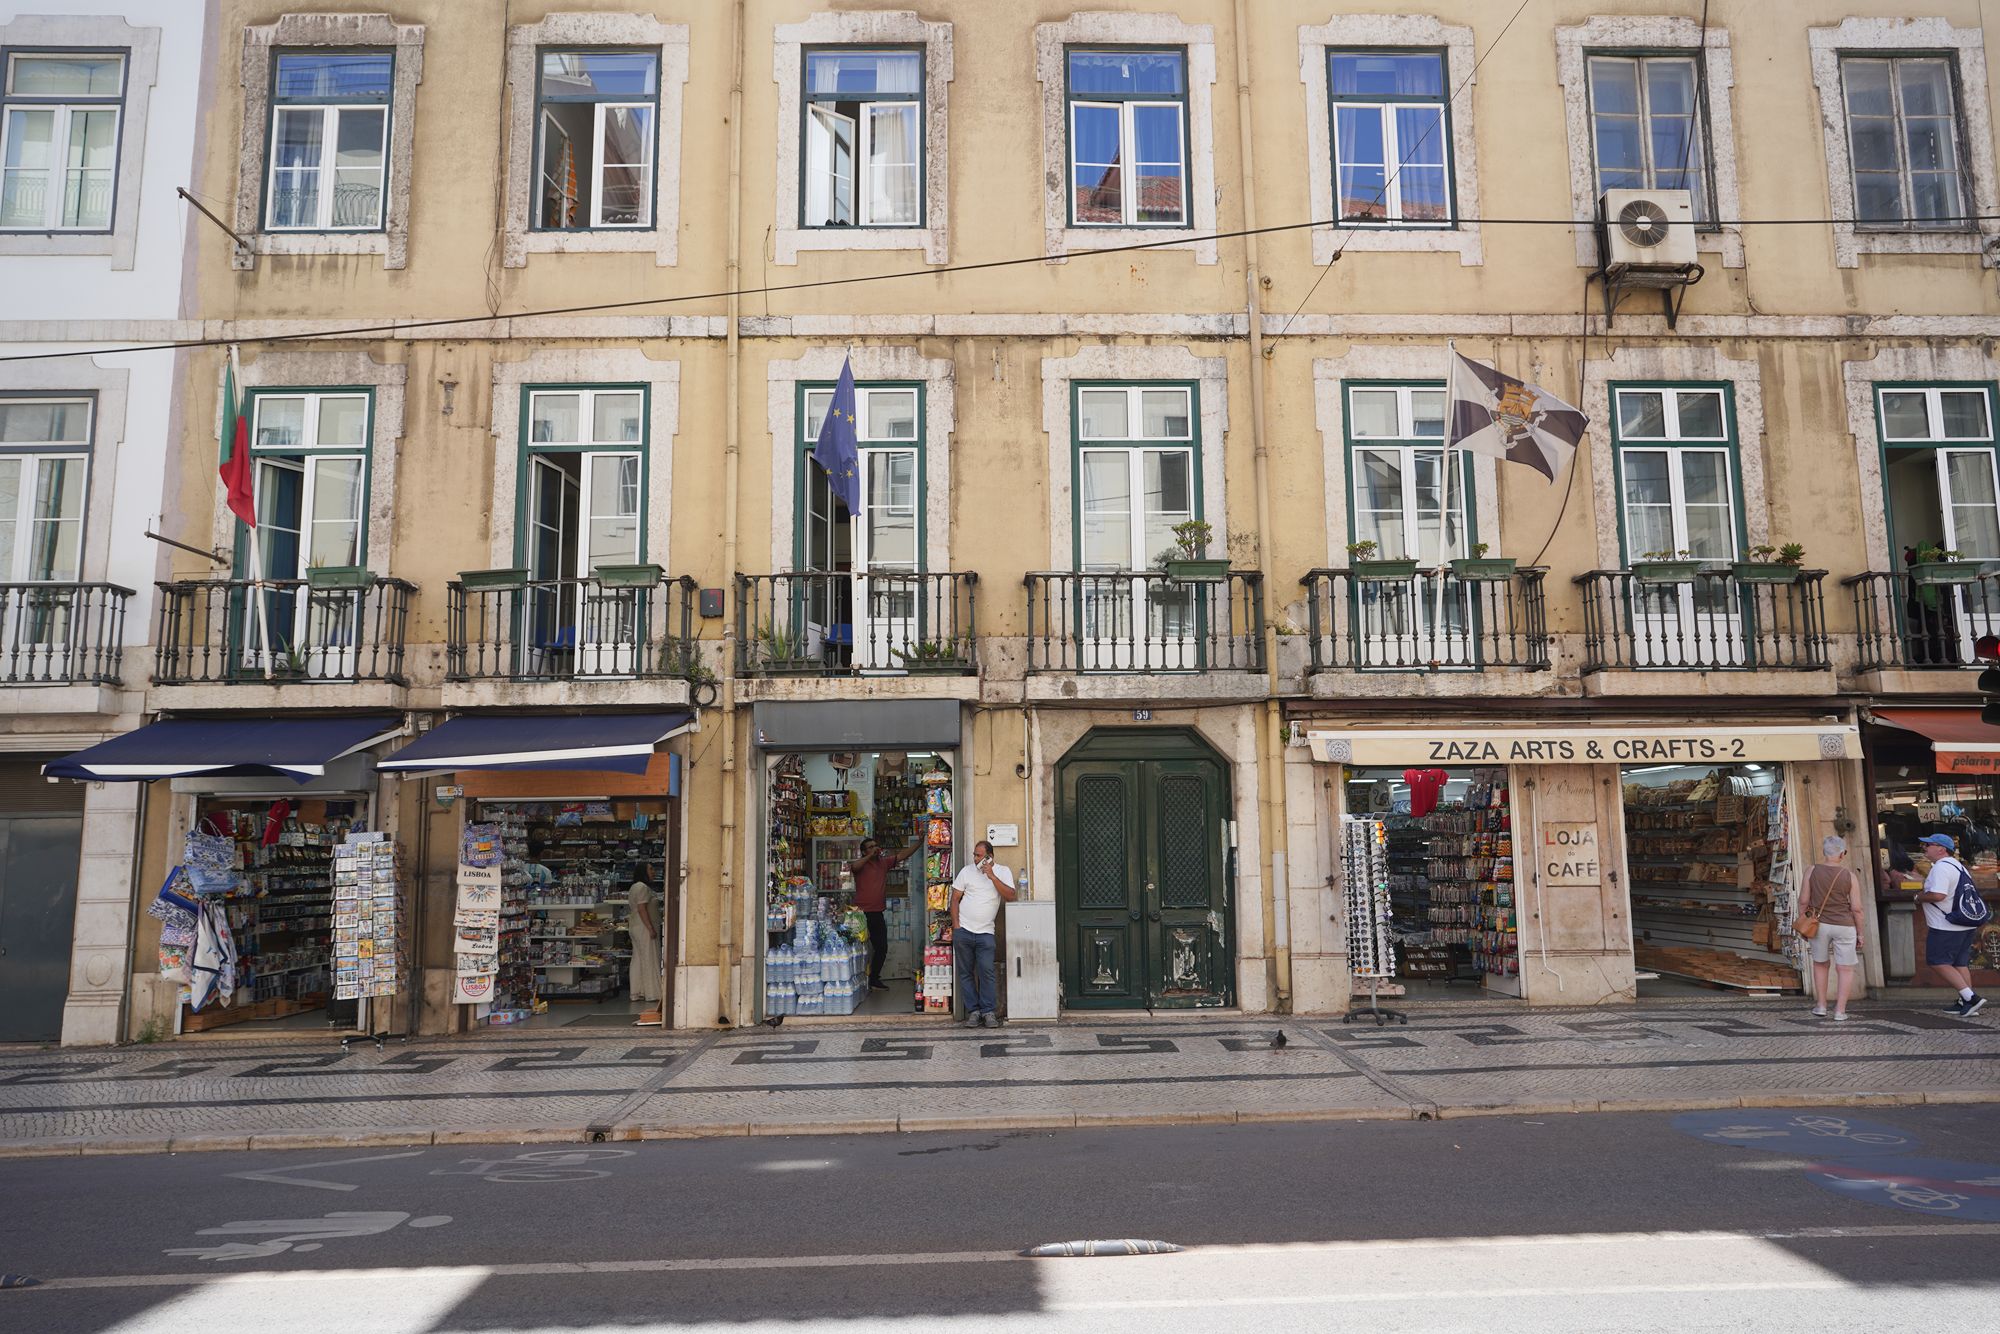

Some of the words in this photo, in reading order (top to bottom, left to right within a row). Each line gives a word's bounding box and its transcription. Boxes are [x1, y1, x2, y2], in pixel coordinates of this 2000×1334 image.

[1136, 710, 1149, 720] 59
[1429, 741, 1500, 760] ZAZA
[1510, 740, 1575, 760] ARTS
[1586, 740, 1604, 760] &
[1545, 830, 1594, 846] LOJA
[1547, 858, 1599, 878] CAFÉ
